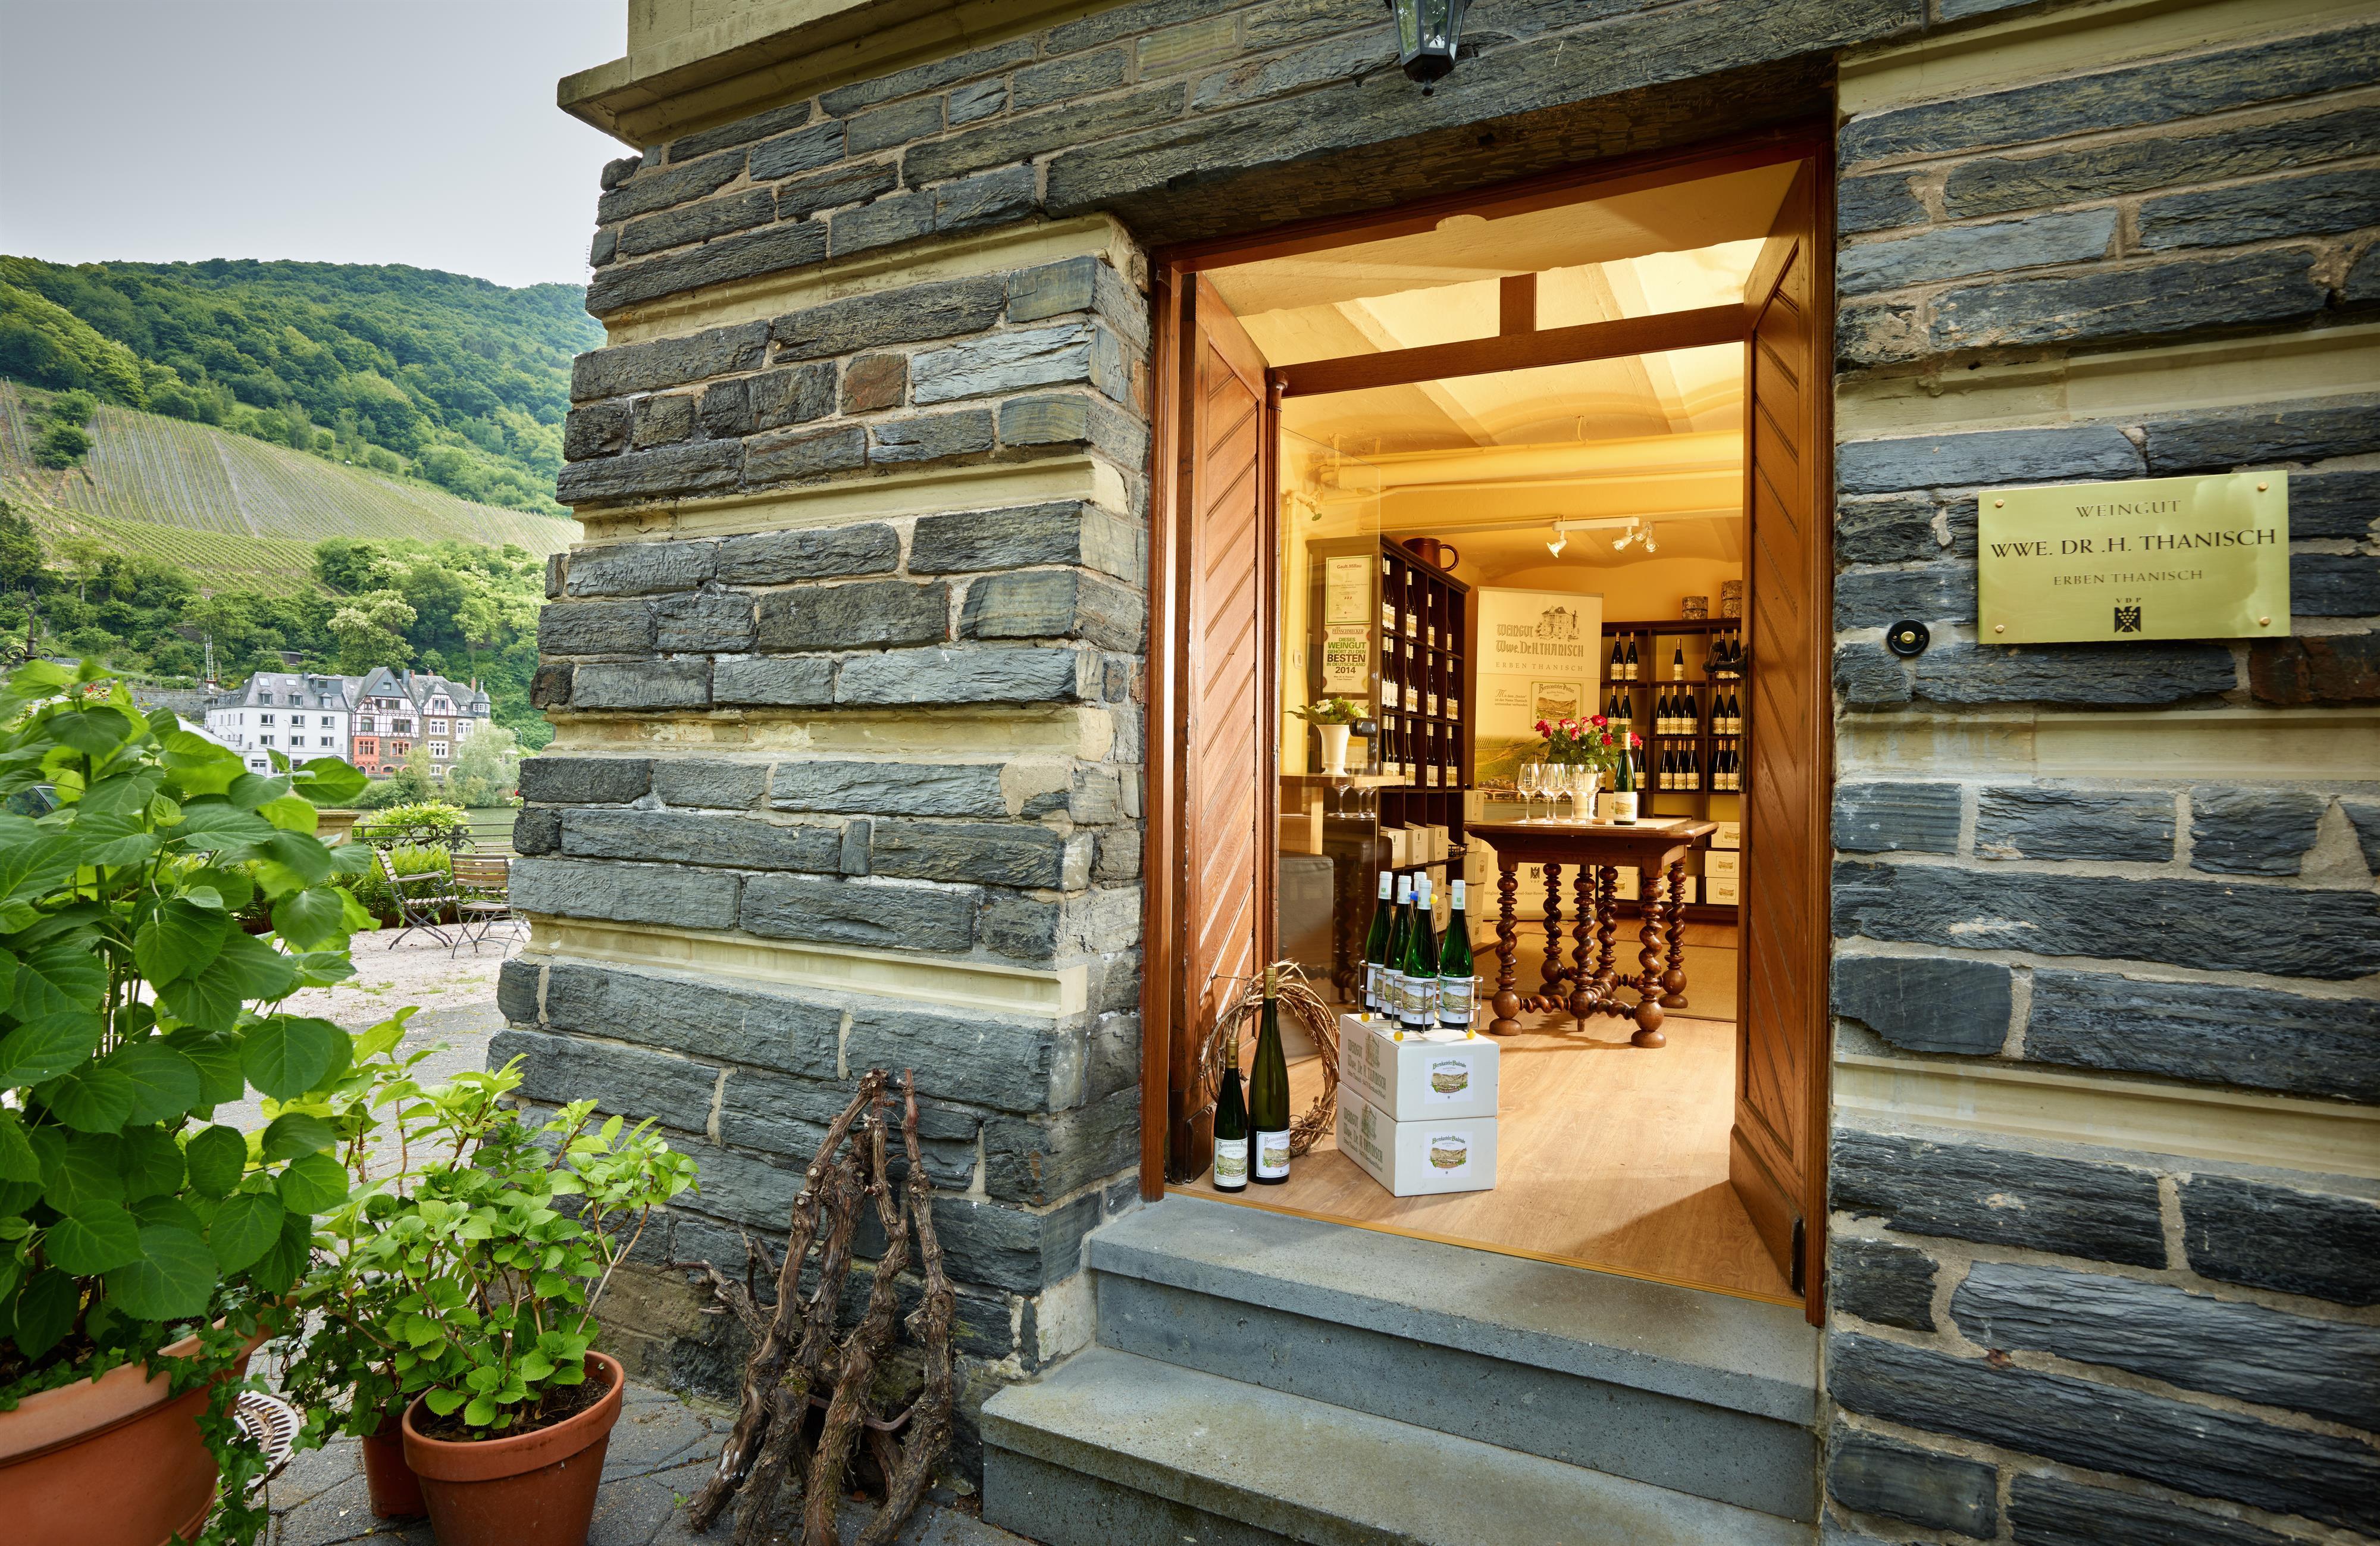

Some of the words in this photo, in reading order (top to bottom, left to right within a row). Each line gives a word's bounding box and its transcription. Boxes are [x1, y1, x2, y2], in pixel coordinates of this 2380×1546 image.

[2076, 500, 2181, 518] WEINGUT
[1990, 540, 2053, 558] WWE.
[2139, 528, 2276, 550] THANISCH
[2054, 574, 2105, 586] ERBEN
[2111, 570, 2202, 583] THANISCH
[1327, 654, 1366, 662] BESTEN
